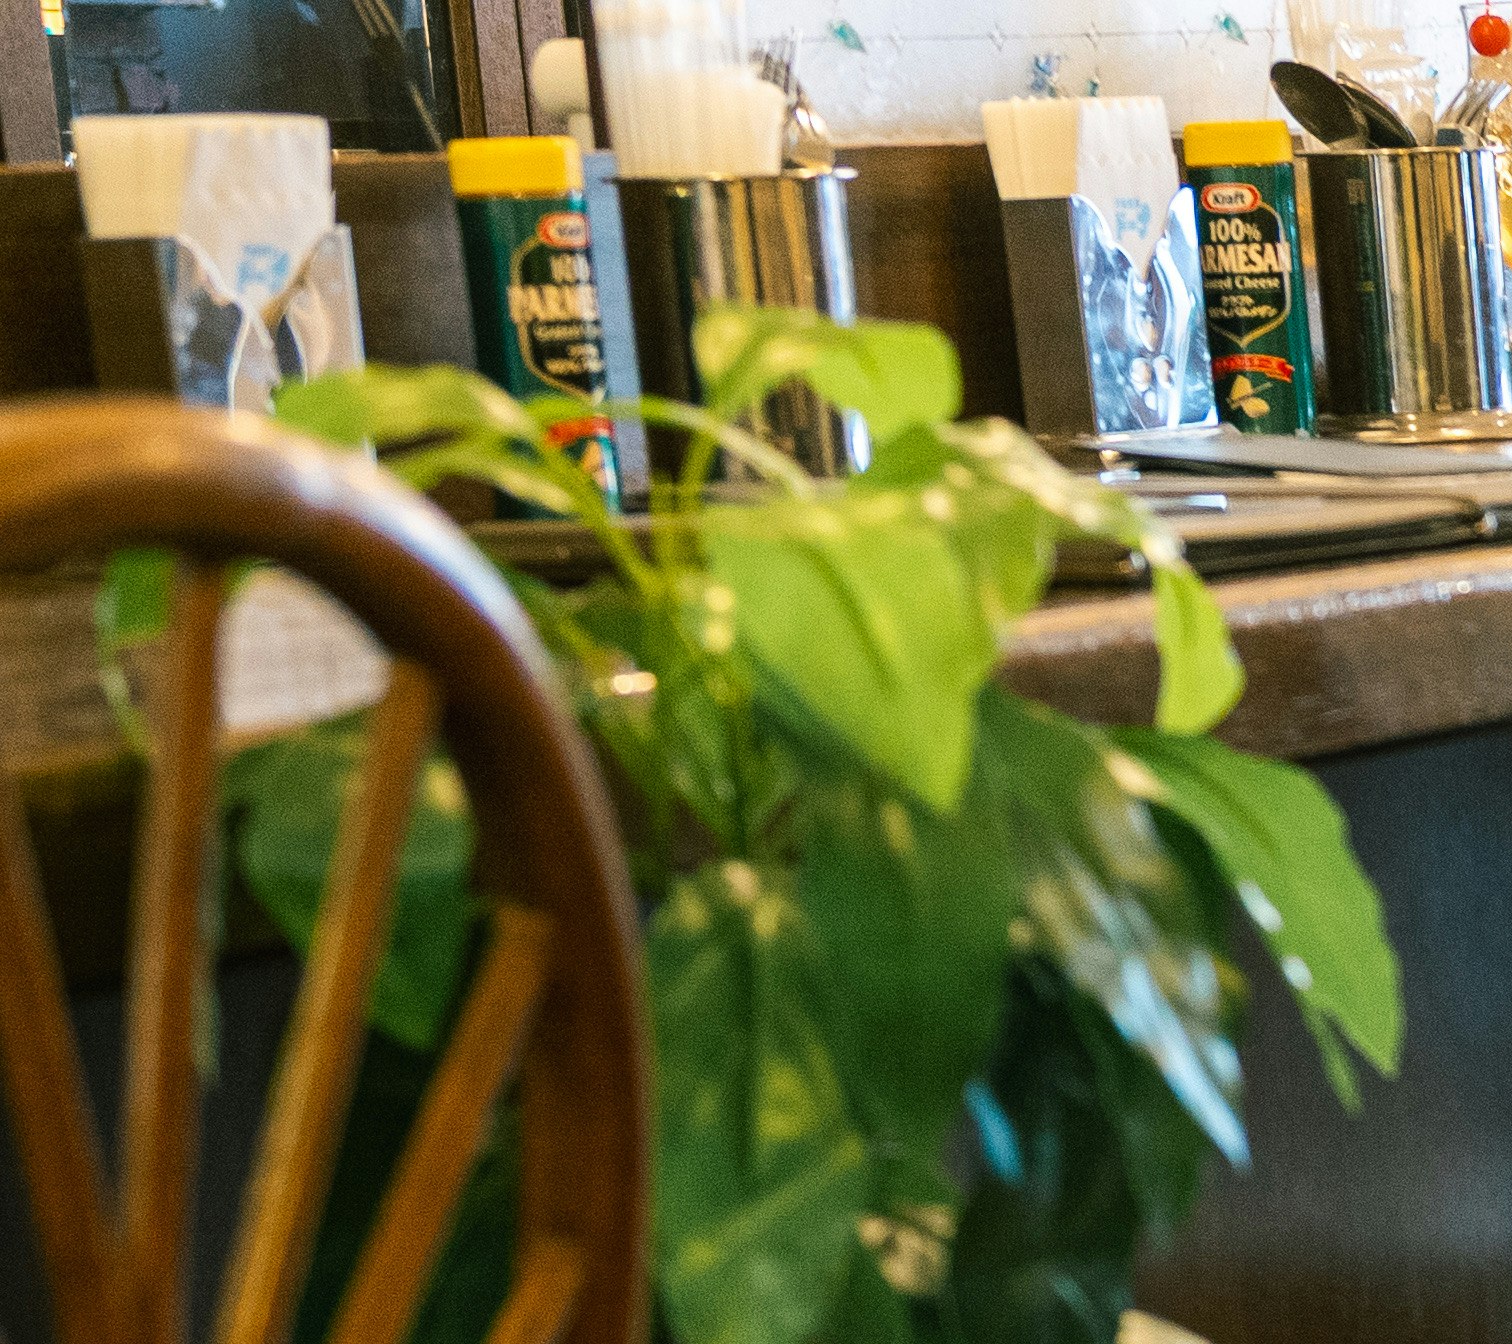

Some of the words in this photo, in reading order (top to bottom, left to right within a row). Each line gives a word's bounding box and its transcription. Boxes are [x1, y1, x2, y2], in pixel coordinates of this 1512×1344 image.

[1213, 191, 1245, 205] Kraft
[1209, 218, 1262, 243] 100%
[1200, 242, 1291, 273] RMESAN
